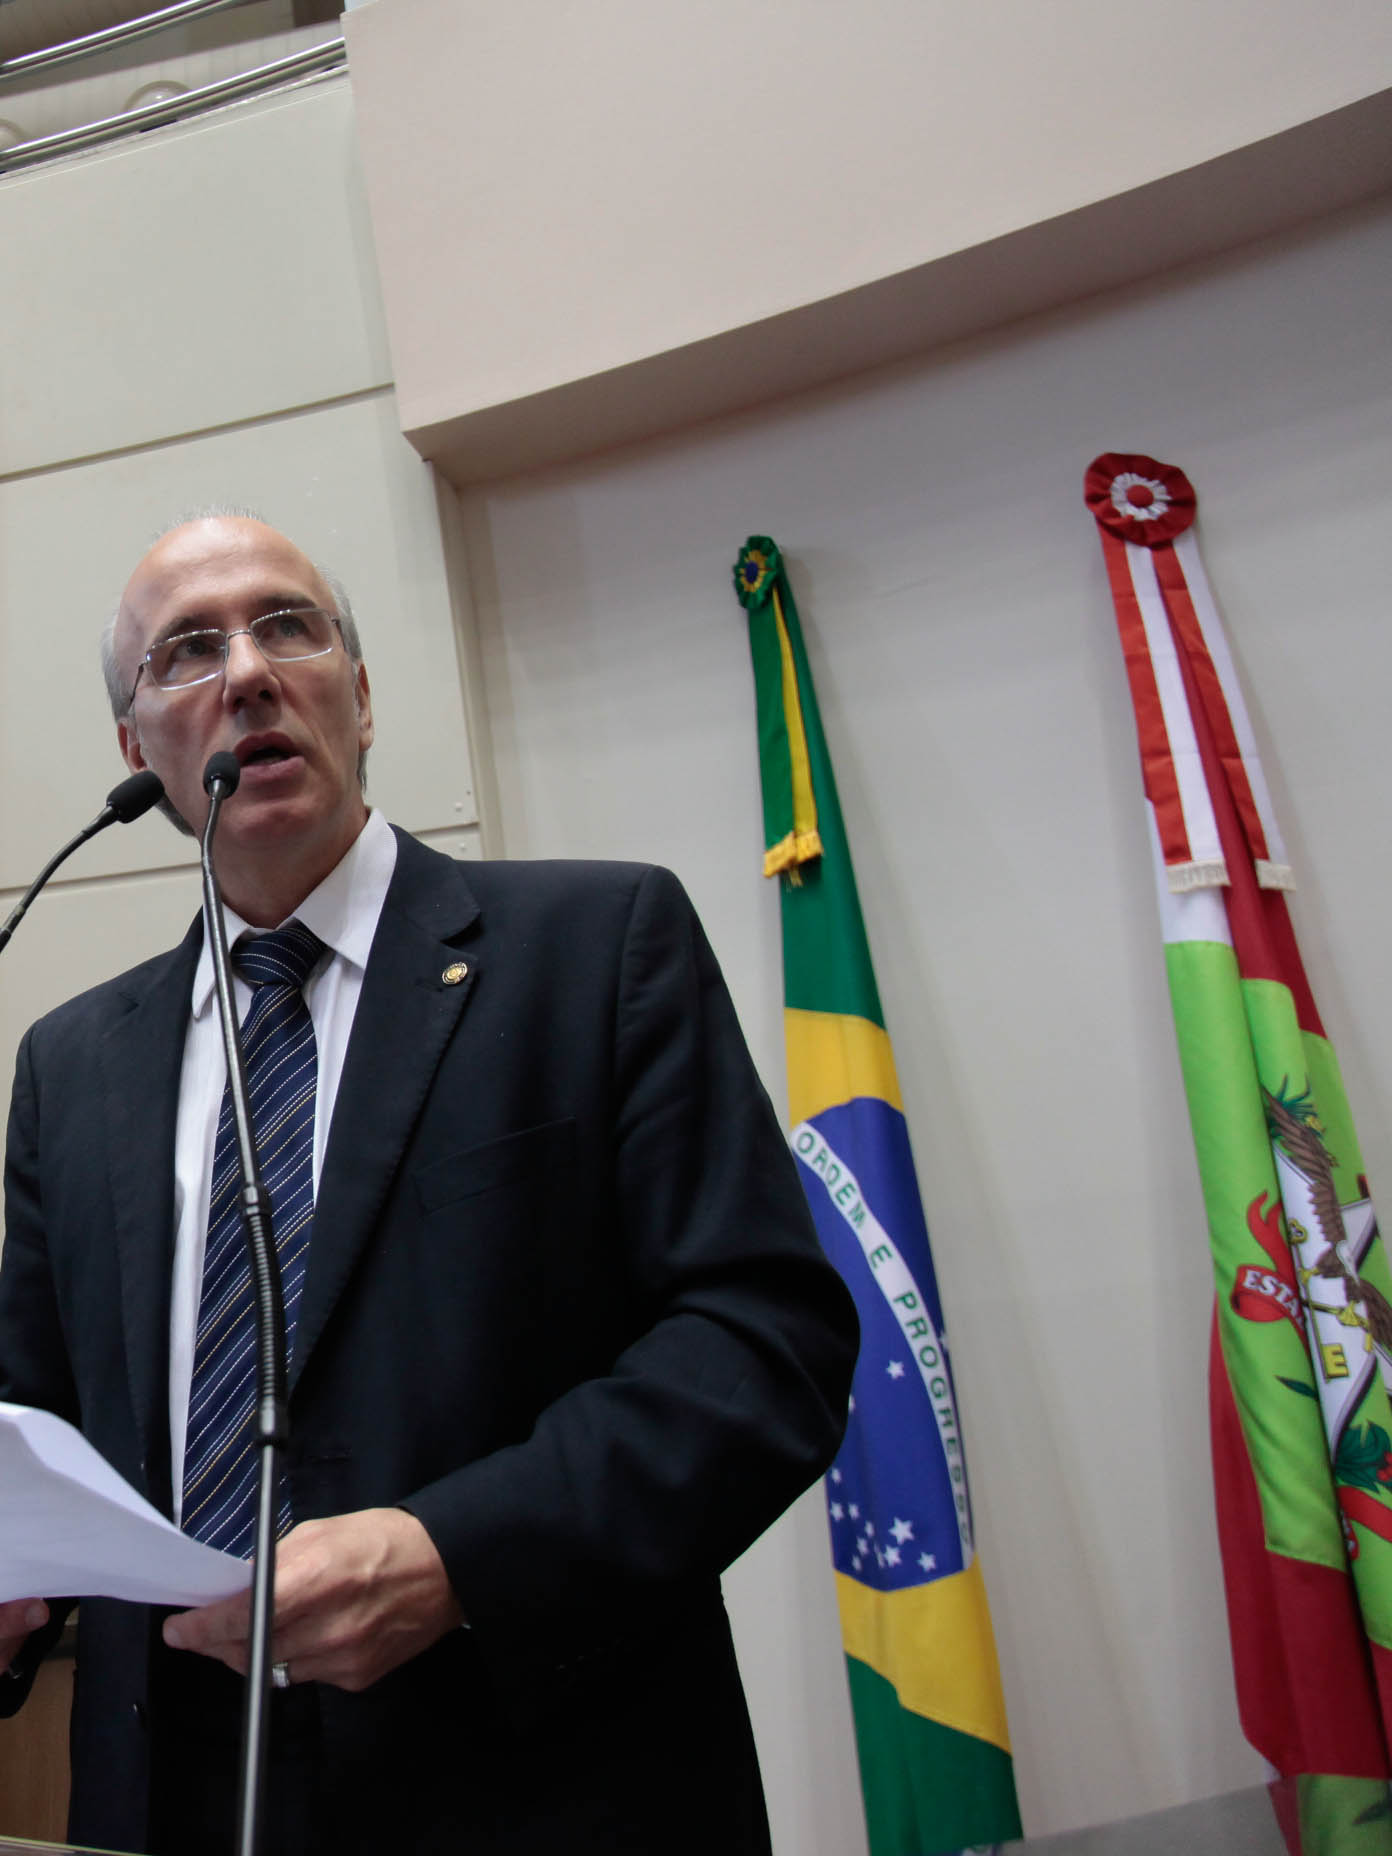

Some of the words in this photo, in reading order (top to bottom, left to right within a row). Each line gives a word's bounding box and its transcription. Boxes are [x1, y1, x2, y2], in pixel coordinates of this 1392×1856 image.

[796, 1132, 866, 1230] ORDEM
[870, 1244, 893, 1269] E
[1243, 1269, 1306, 1330] ESTA
